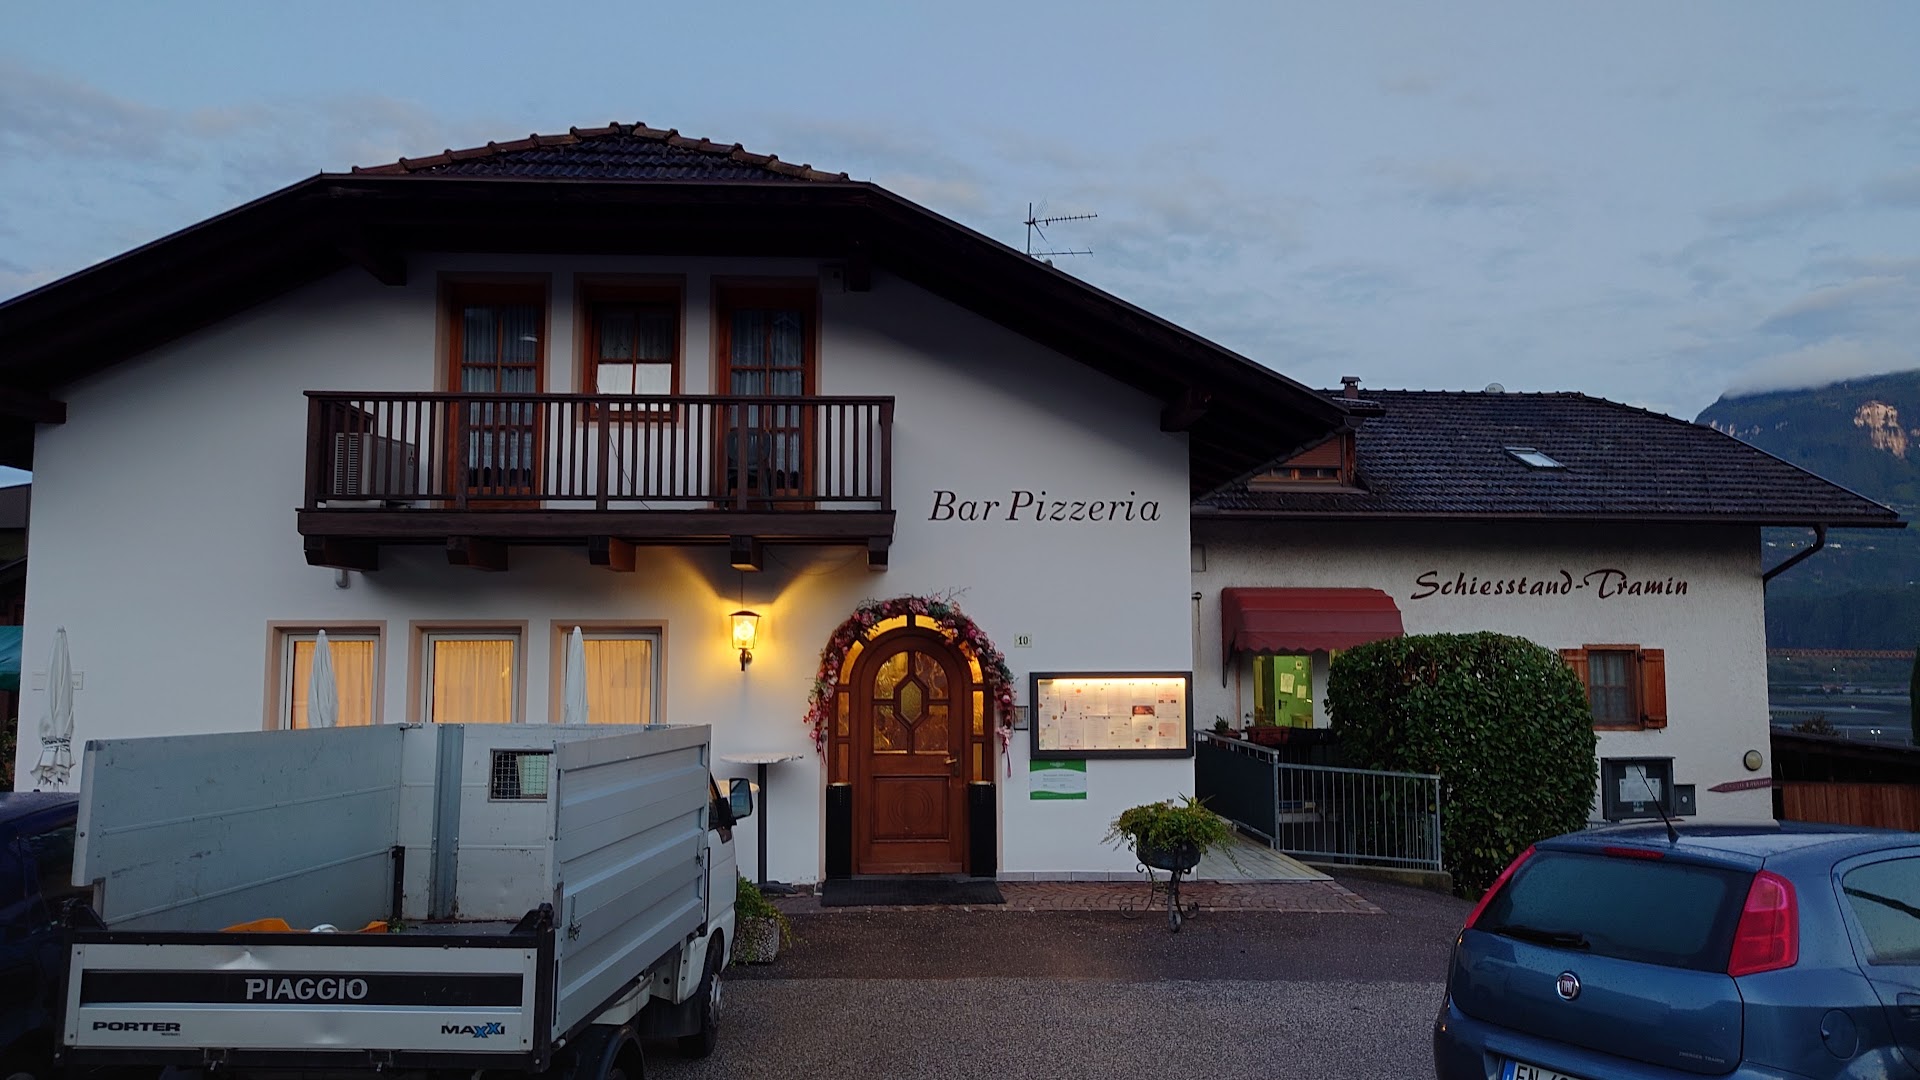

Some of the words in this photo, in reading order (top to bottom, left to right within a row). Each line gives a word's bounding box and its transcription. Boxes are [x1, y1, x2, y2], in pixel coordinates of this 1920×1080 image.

[928, 490, 1000, 521] Bar
[1005, 490, 1161, 521] Pizzeria
[1410, 568, 1689, 600] Schiesstand-Tramin
[1018, 635, 1029, 646] 10
[245, 978, 369, 1000] PIAGGIO
[92, 1021, 181, 1032] PORTER
[441, 1022, 506, 1038] MAXXI
